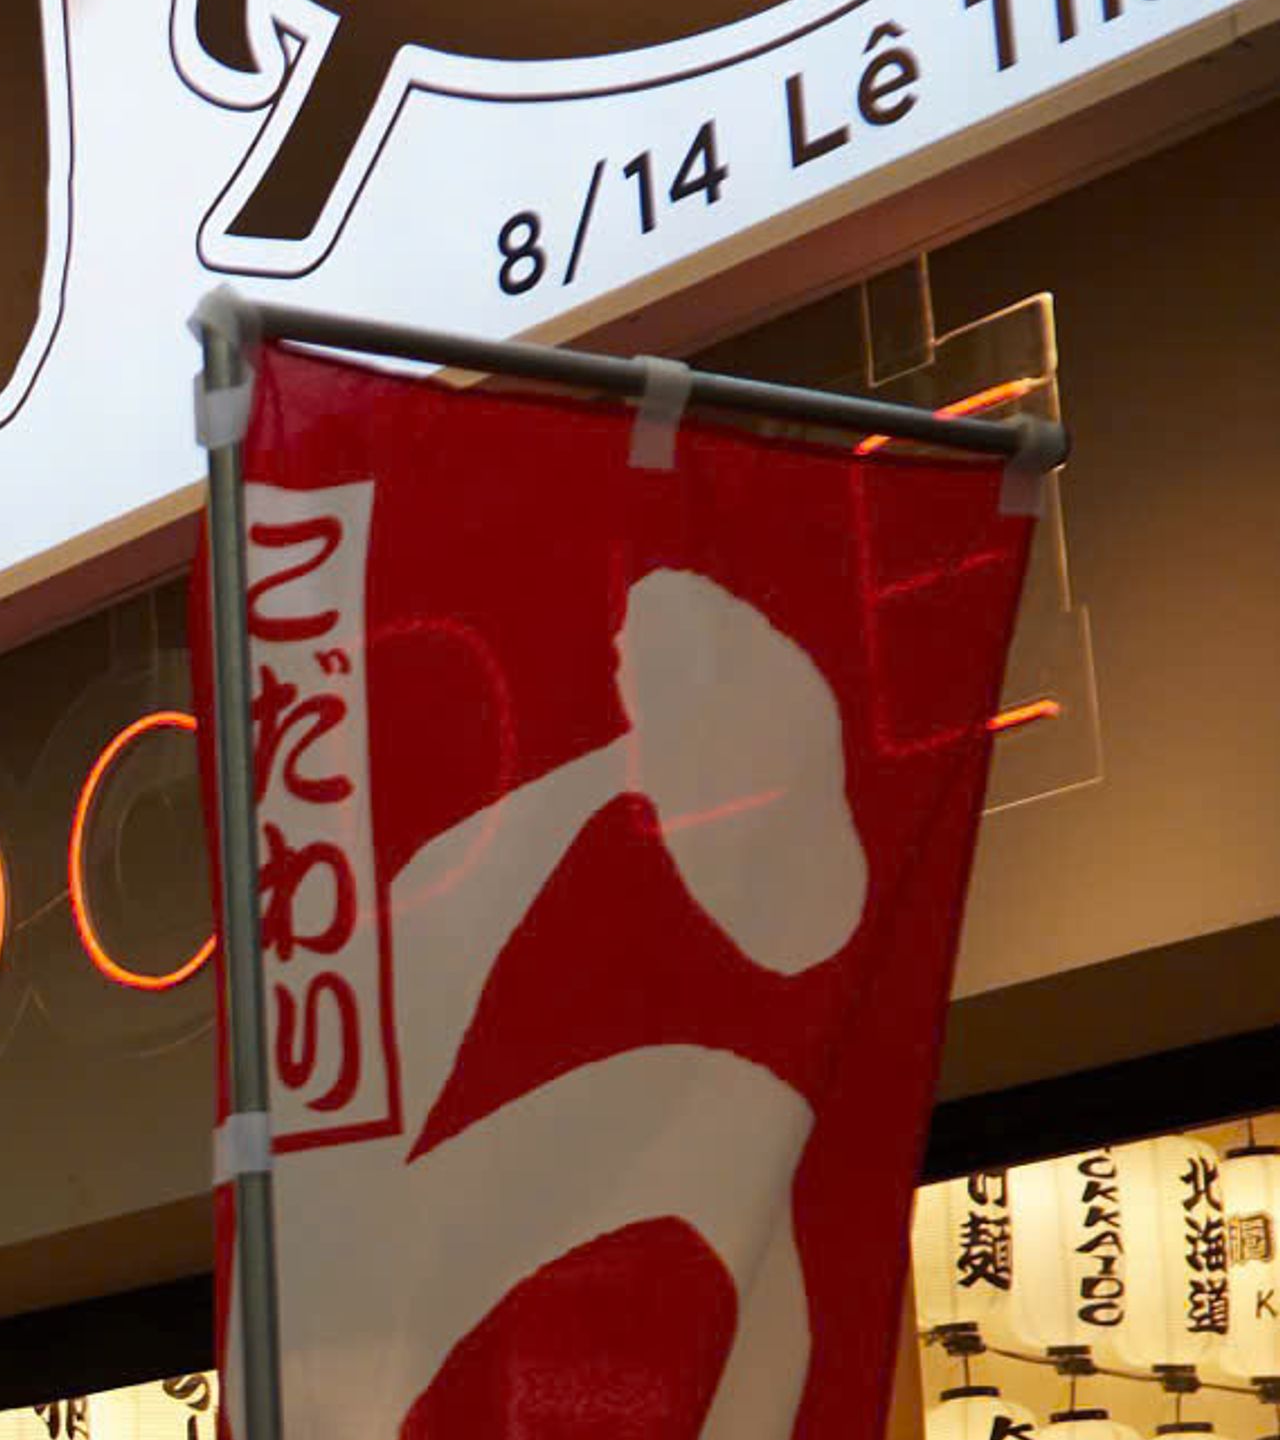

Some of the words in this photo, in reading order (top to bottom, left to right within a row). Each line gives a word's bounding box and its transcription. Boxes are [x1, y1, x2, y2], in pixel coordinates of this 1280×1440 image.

[497, 120, 729, 295] 8/14
[785, 21, 920, 169] Lê
[245, 520, 362, 1116] こだわり
